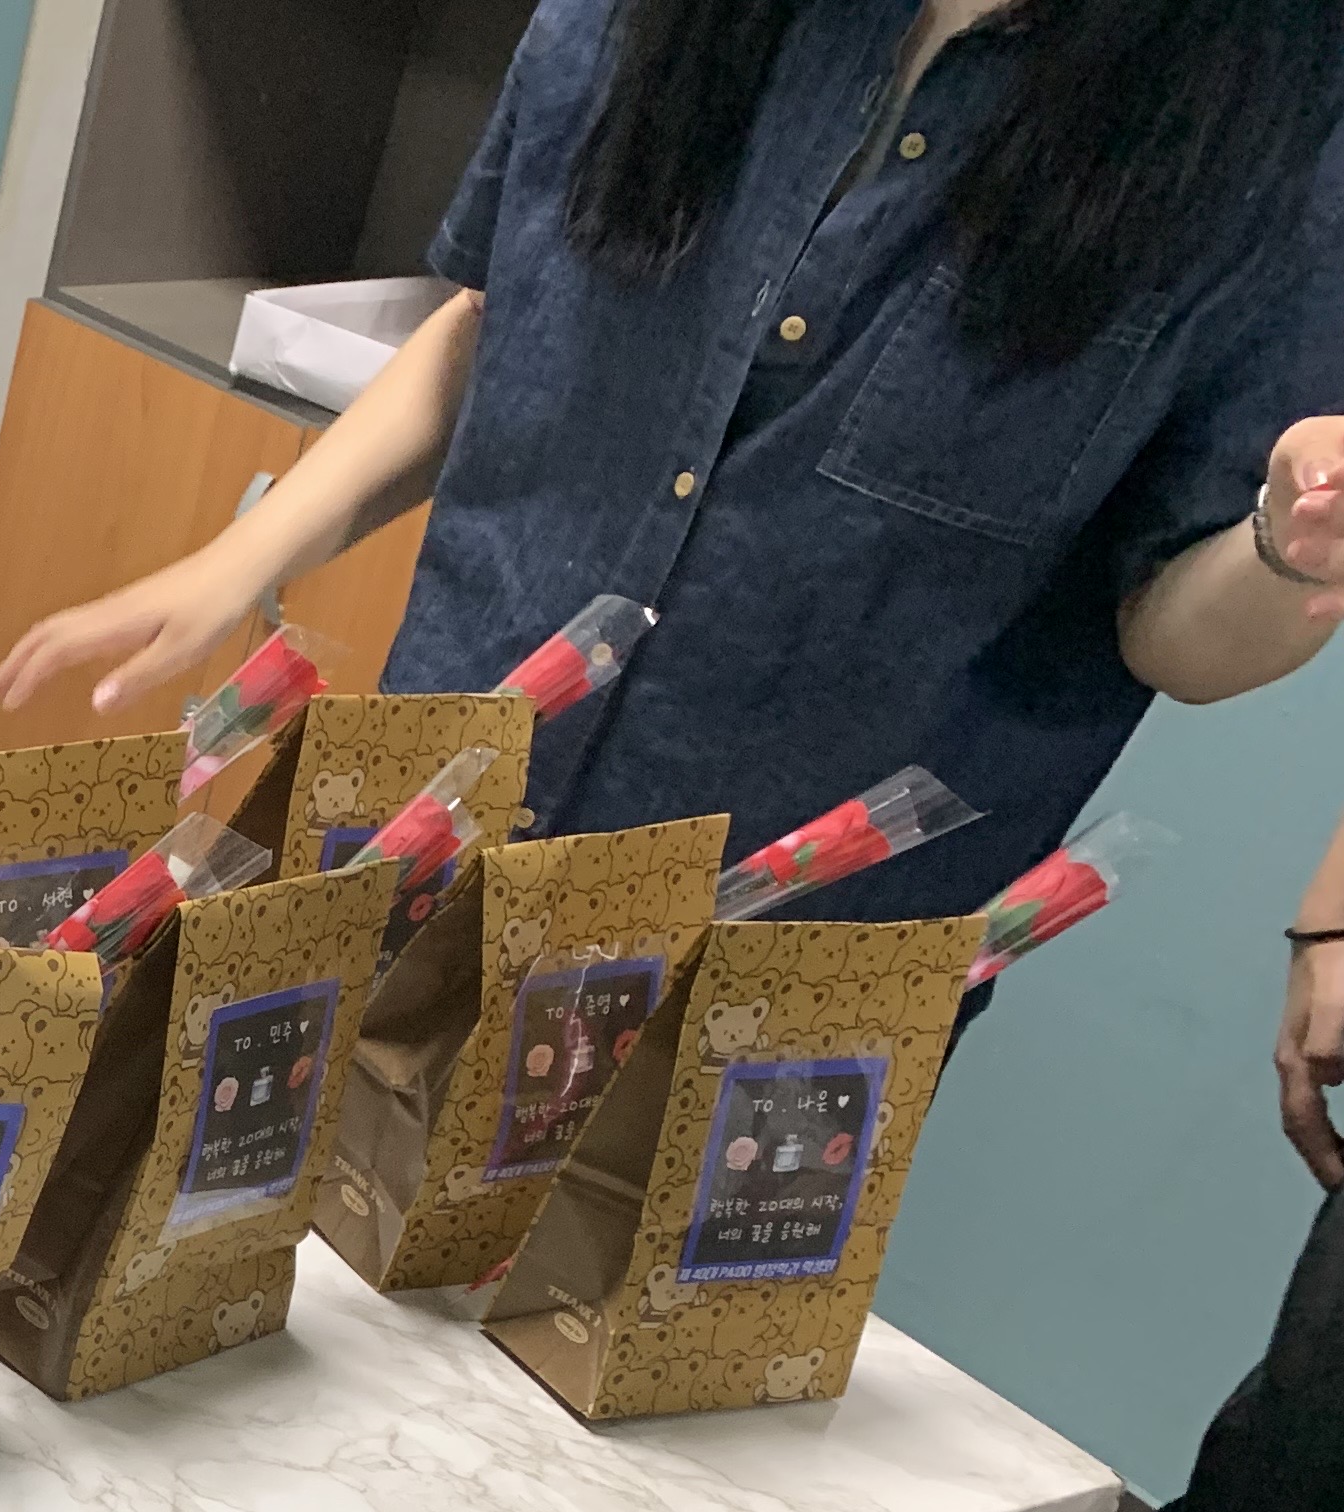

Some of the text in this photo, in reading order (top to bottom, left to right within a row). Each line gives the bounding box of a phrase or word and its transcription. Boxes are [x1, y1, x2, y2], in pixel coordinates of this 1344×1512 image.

[585, 993, 611, 1016] 준영
[269, 1020, 292, 1044] 민주
[797, 1090, 828, 1113] 나은
[514, 1104, 551, 1123] 행복한
[201, 1136, 233, 1161] 행복한
[238, 1124, 275, 1147] 20대의
[709, 1197, 751, 1219] 행복한
[758, 1196, 805, 1213] 20대의
[717, 1221, 822, 1244] 너의 꿈을 응원해
